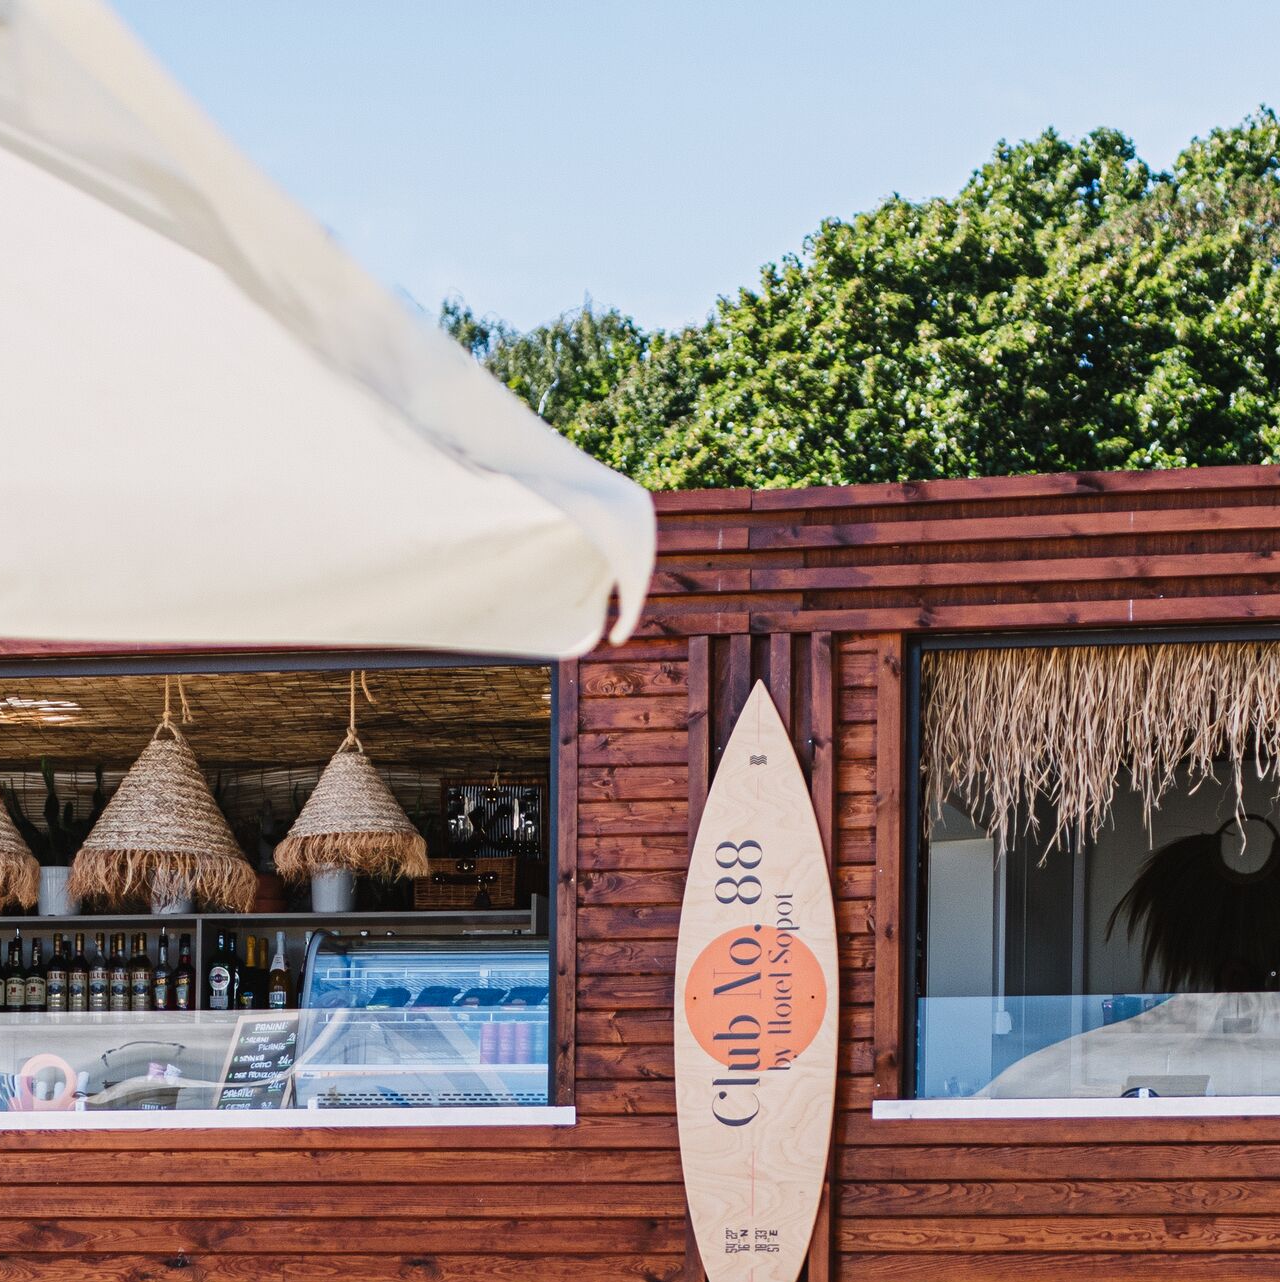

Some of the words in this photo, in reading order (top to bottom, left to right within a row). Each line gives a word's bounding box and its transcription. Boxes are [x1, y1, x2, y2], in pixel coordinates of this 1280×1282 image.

[714, 839, 763, 905] 88
[713, 924, 762, 998] No.
[767, 892, 801, 964] Sopot
[767, 972, 793, 1035] Hotel
[712, 1014, 762, 1127] Club
[767, 1049, 799, 1071] by
